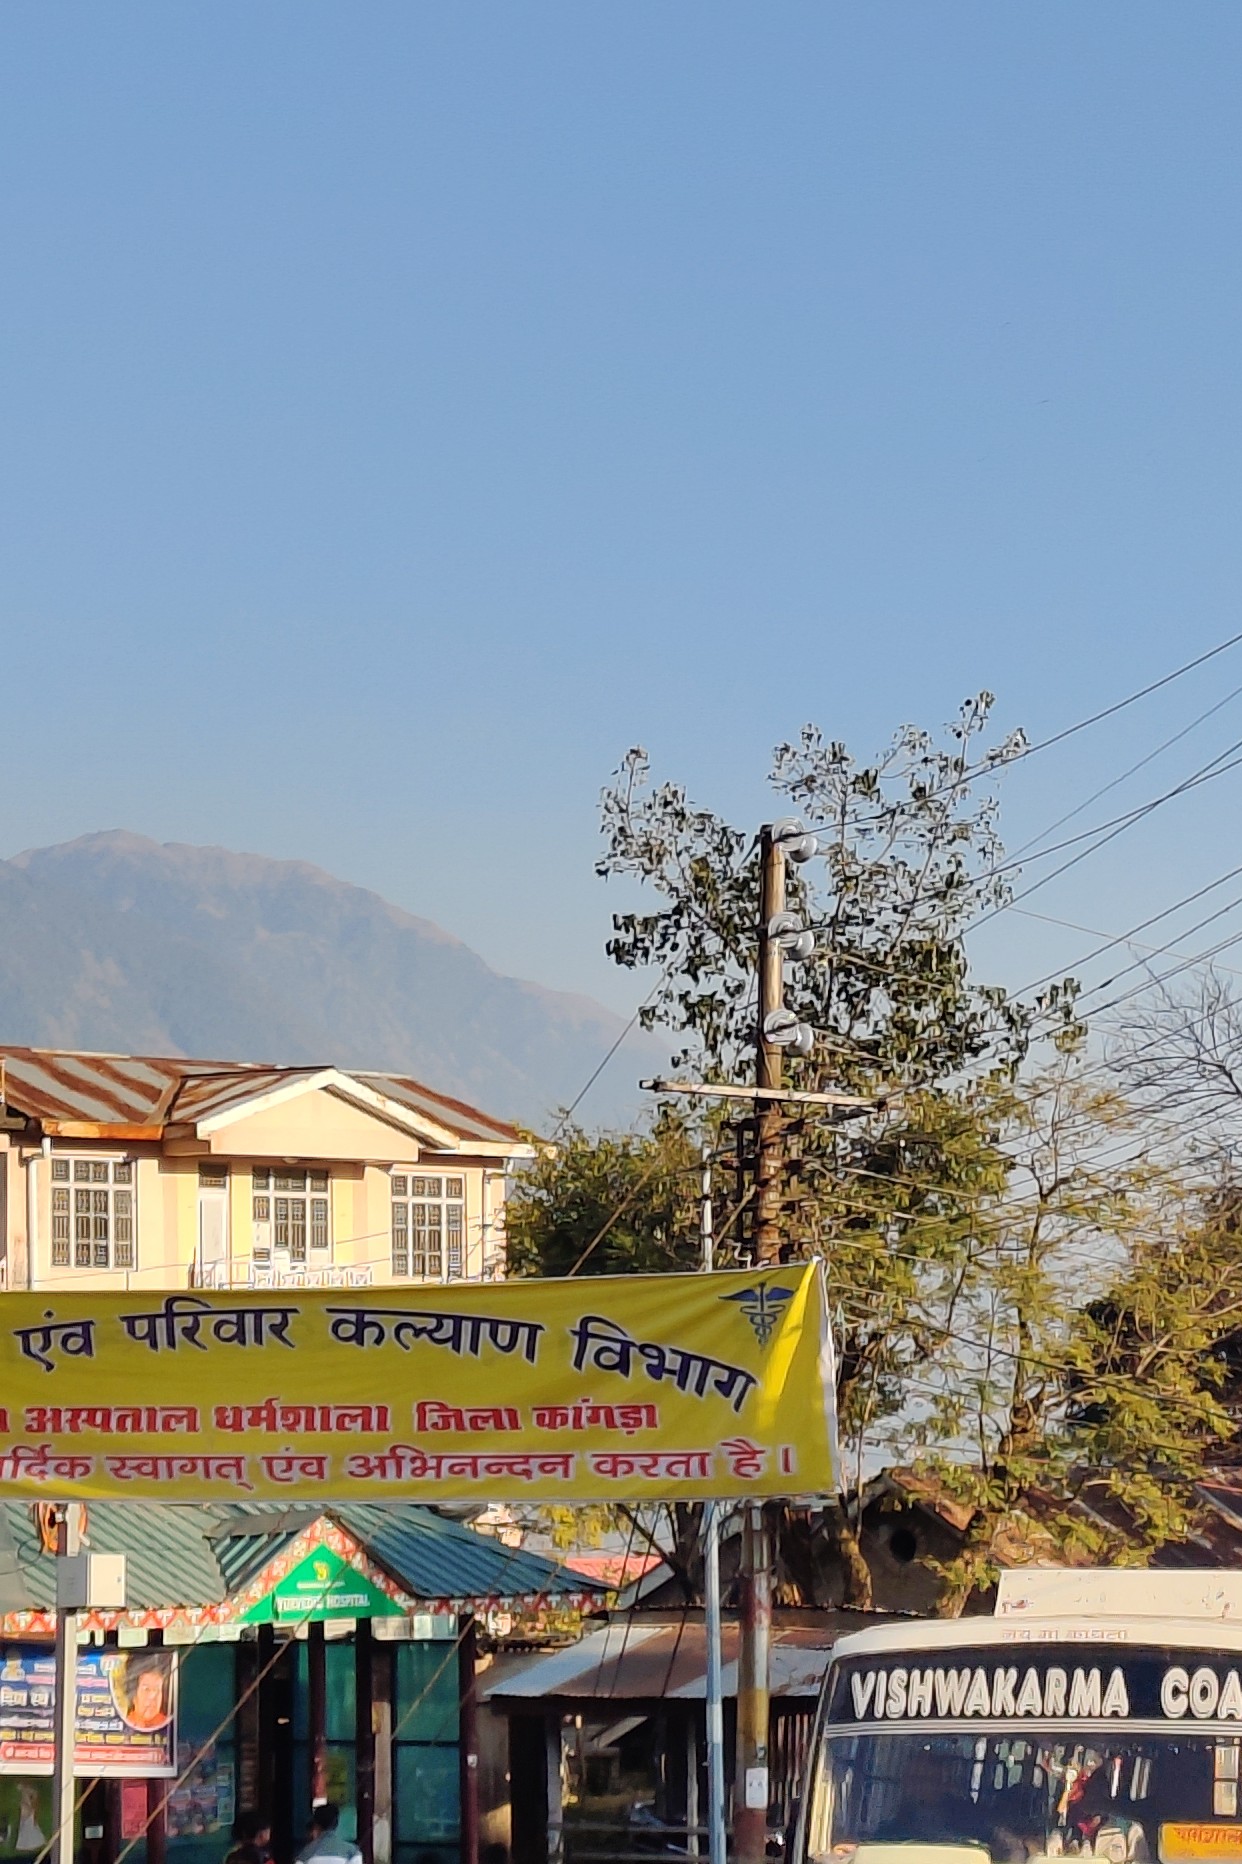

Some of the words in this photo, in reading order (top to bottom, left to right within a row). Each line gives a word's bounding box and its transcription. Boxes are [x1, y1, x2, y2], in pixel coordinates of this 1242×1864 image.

[119, 1296, 300, 1350] परिवार
[326, 1307, 545, 1364] कल्याण
[570, 1315, 758, 1412] विभाग
[24, 1406, 199, 1433] अस्पताल
[214, 1396, 390, 1433] धर्मशाला
[417, 1401, 521, 1433] जिला
[532, 1398, 657, 1435] कांगड़ा
[0, 1444, 93, 1482] ार्दिक
[105, 1455, 253, 1491] स्वागत्
[348, 1445, 575, 1481] अभिनन्दन
[592, 1452, 711, 1478] करता
[851, 1667, 1130, 1720] VISHWAKARMA
